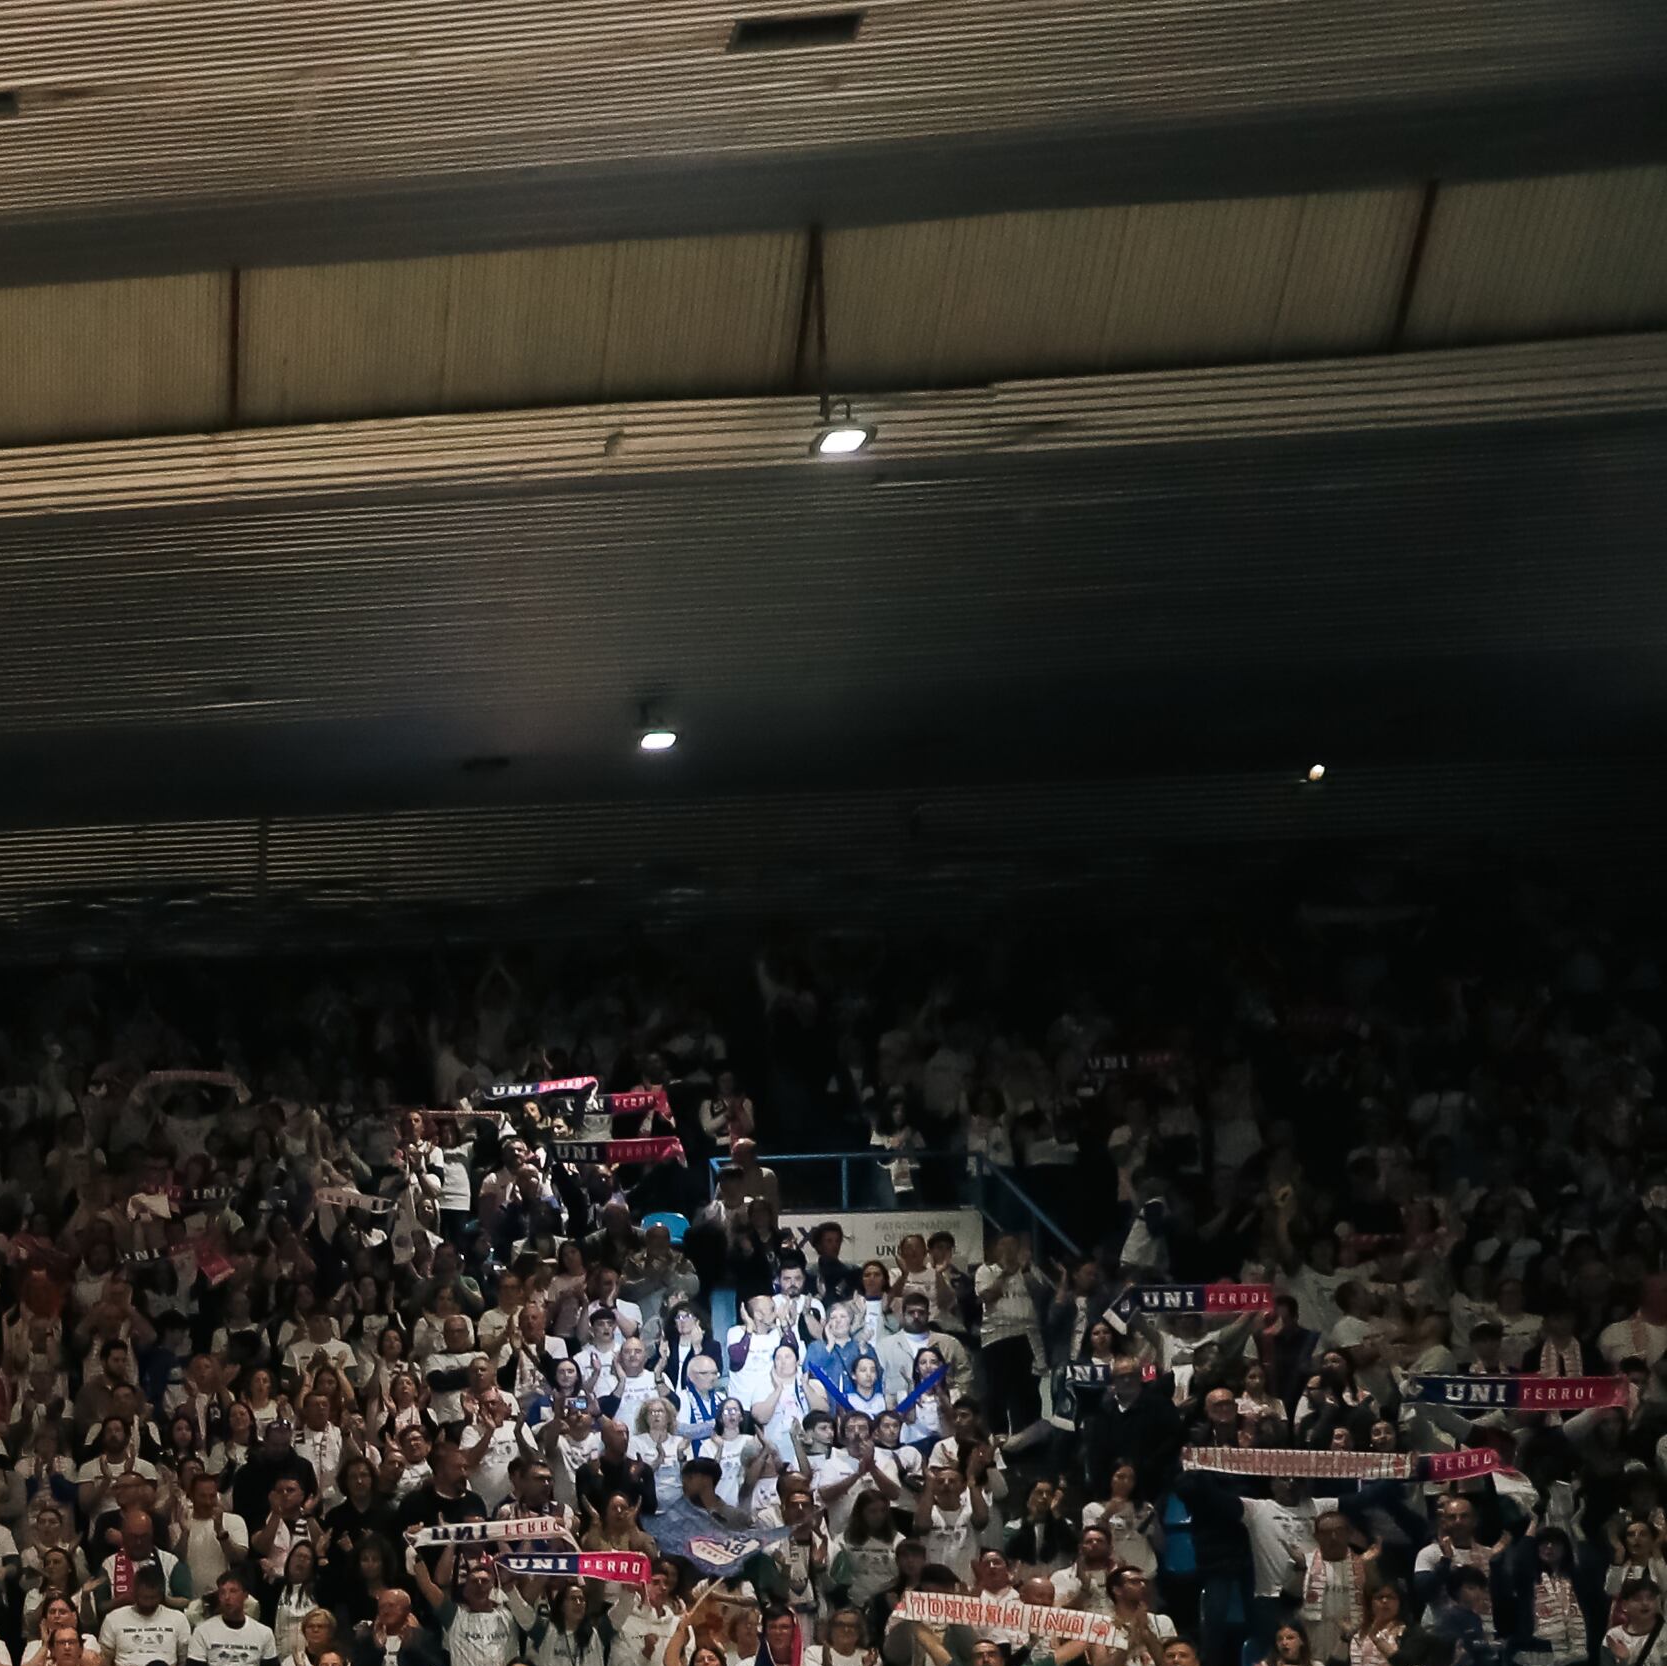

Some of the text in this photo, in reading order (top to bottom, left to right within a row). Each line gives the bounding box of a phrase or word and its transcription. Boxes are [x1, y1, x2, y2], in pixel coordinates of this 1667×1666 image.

[492, 1085, 533, 1097] UNI
[555, 1144, 598, 1159] UNI
[1142, 1290, 1269, 1308] UNI FERROL
[1445, 1382, 1595, 1402] UNI FERROL
[506, 1557, 569, 1572] UNI
[911, 1595, 1085, 1635] UNI FERROL
